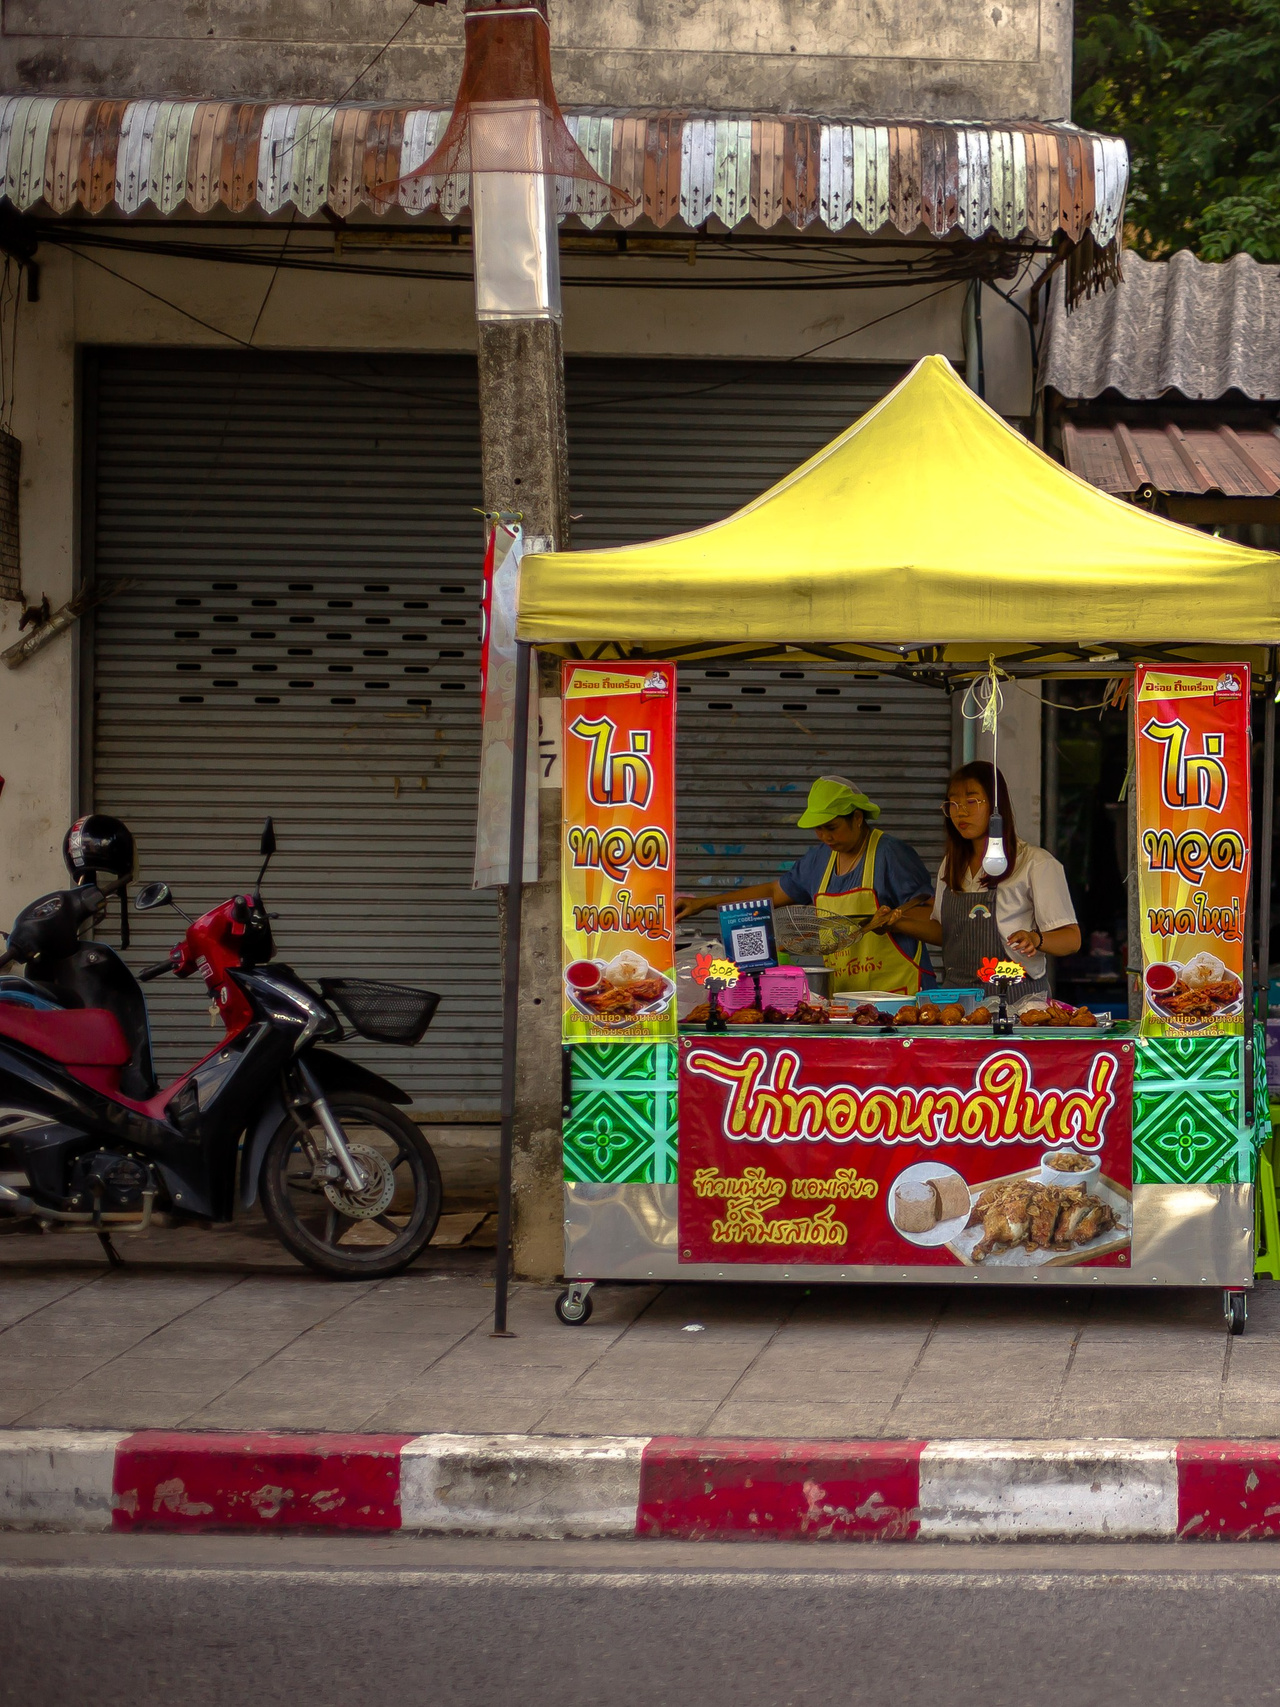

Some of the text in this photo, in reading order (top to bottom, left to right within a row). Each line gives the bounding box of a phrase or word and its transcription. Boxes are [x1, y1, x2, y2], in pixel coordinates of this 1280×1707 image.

[574, 679, 600, 689] อร่อย
[1146, 682, 1172, 692] อร่อย
[569, 715, 654, 810] ไก่
[1142, 717, 1229, 813] ไก่
[568, 825, 670, 882] ทอด
[1142, 828, 1245, 884] ทอด
[573, 890, 671, 941] หาดใหญ่
[1147, 891, 1242, 942] หาดใหญ่
[687, 1047, 1119, 1151] ไก่ทอดหาดใหญ่
[693, 1167, 880, 1202] ข้าวเหนียว หอมเจียว
[711, 1197, 849, 1246] น้ำจิ้มรสเด็ด
